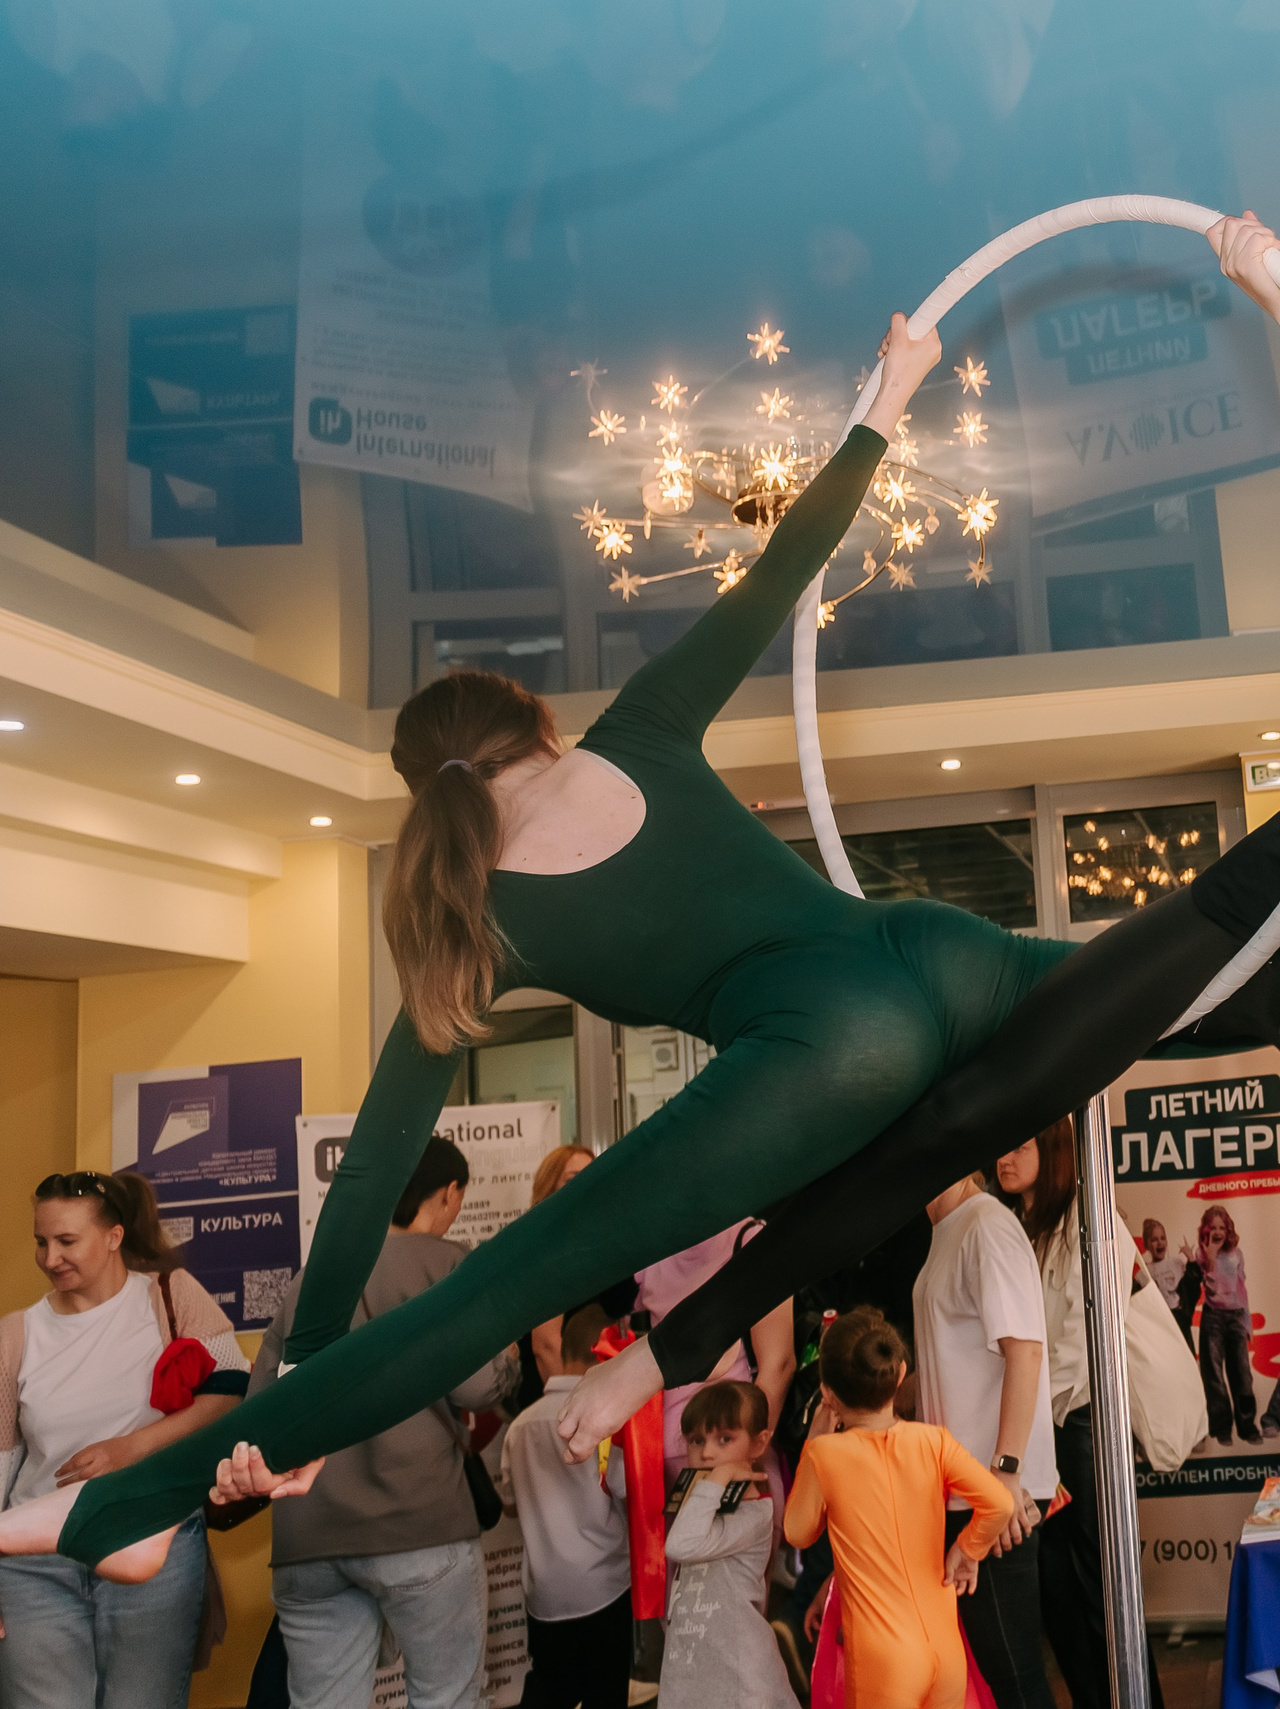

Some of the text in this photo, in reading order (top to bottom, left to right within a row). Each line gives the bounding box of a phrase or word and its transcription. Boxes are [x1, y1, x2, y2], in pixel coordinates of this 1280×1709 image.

[1149, 1079, 1264, 1120] ЛЕТНИЙ
[1199, 1180, 1248, 1194] ДНЕВНОГО
[201, 1212, 283, 1233] КУЛЬТУРА
[1153, 1539, 1217, 1563] (900)
[692, 1599, 721, 1618] days
